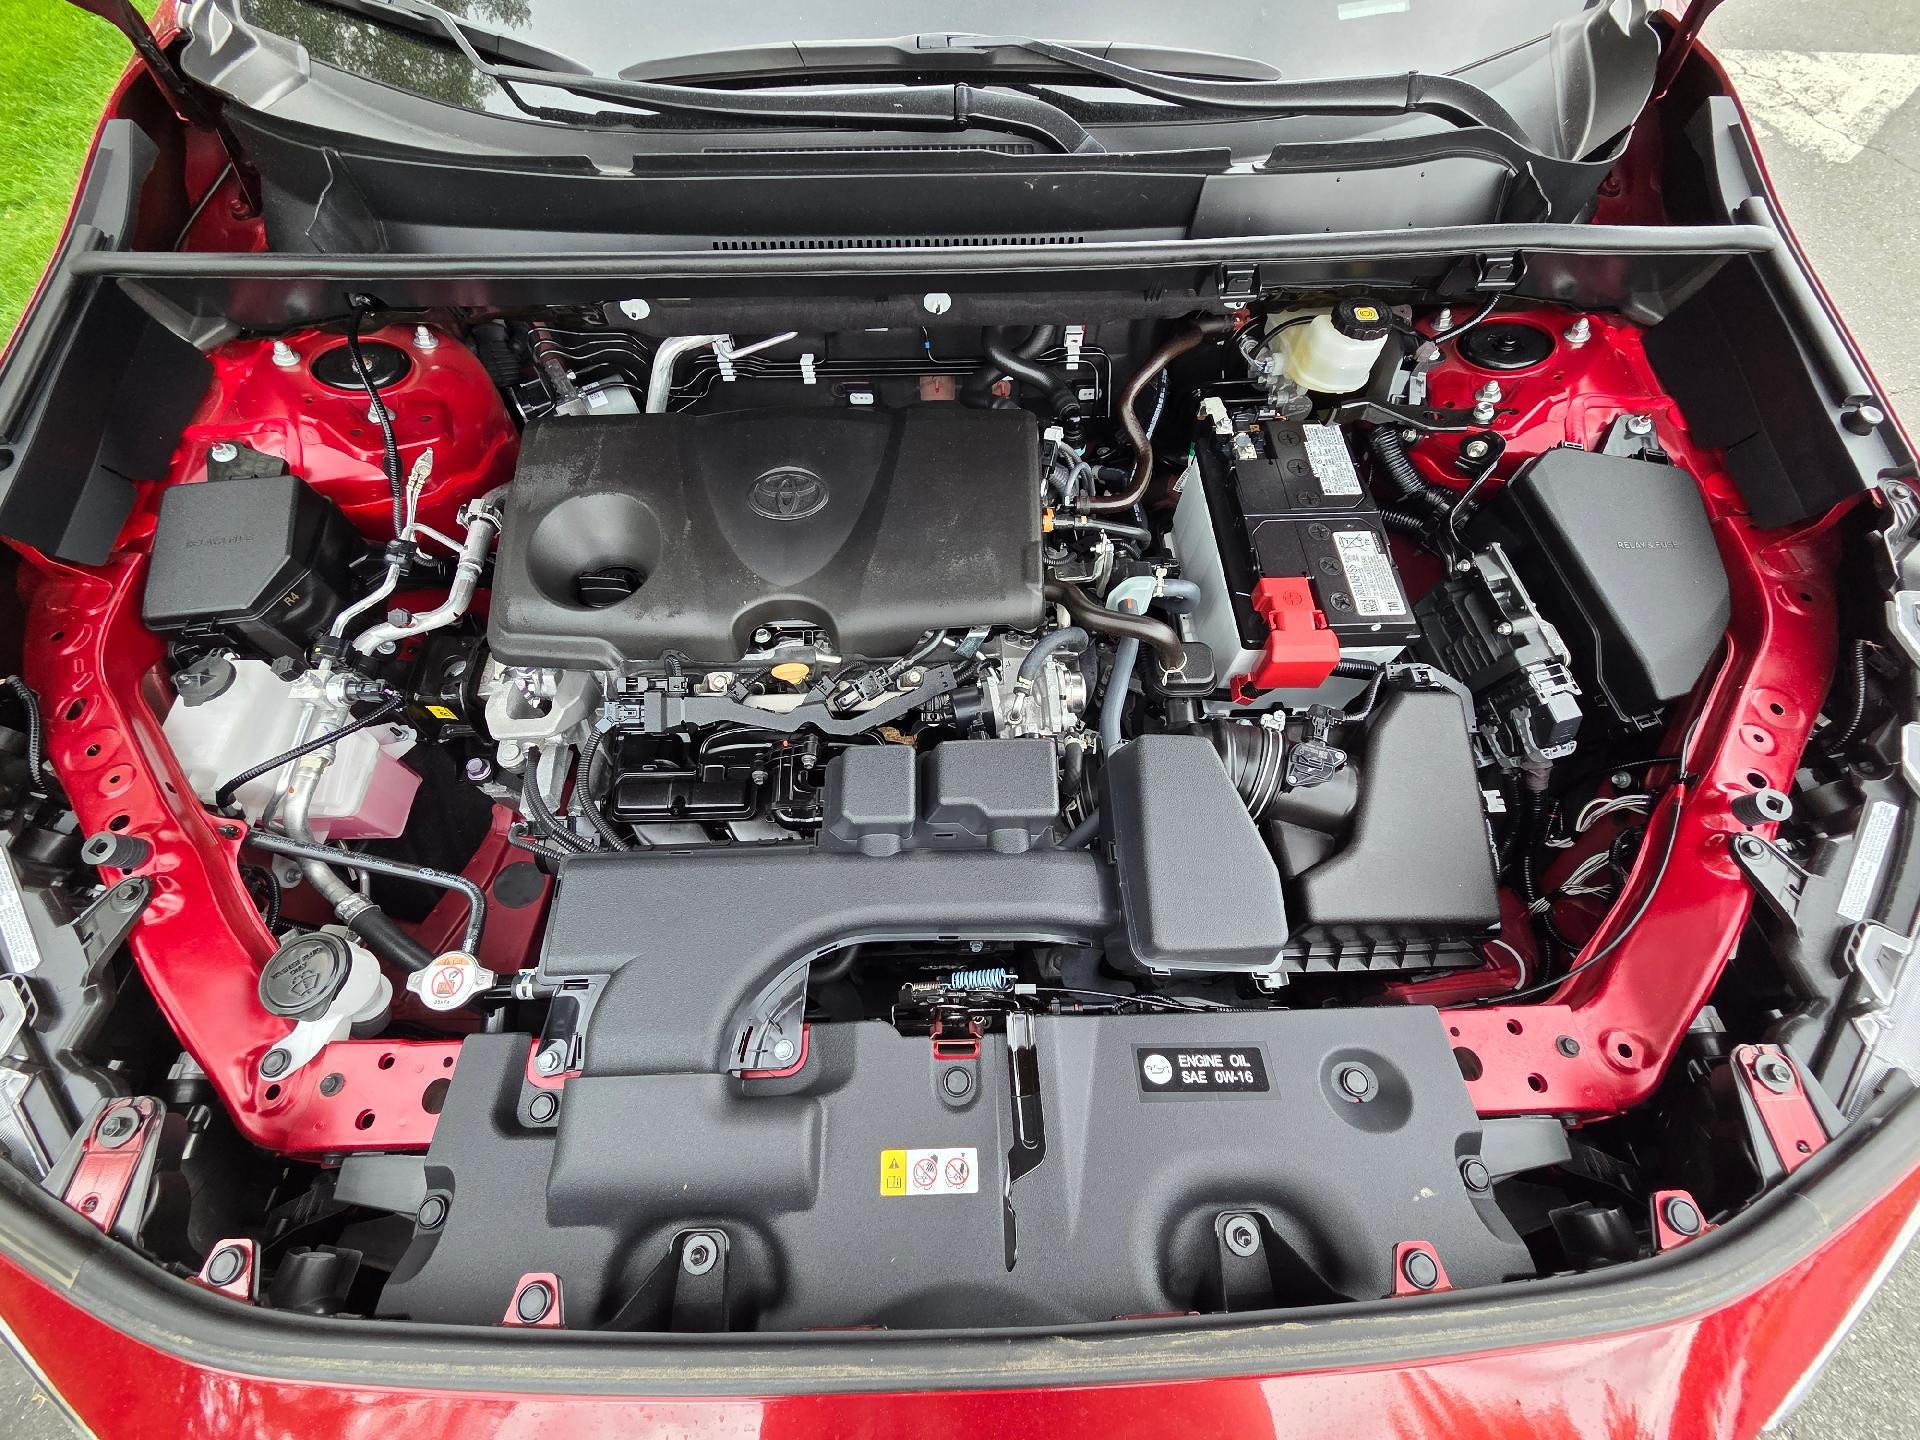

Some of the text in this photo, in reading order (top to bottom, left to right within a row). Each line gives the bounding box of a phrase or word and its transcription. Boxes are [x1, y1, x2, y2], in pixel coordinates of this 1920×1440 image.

[1617, 541, 1645, 549] RELAY
[283, 591, 300, 606] R4
[1387, 601, 1401, 611] TM
[1178, 1054, 1251, 1068] ENGINE OIL
[1181, 1071, 1254, 1084] SAE 0W-16
